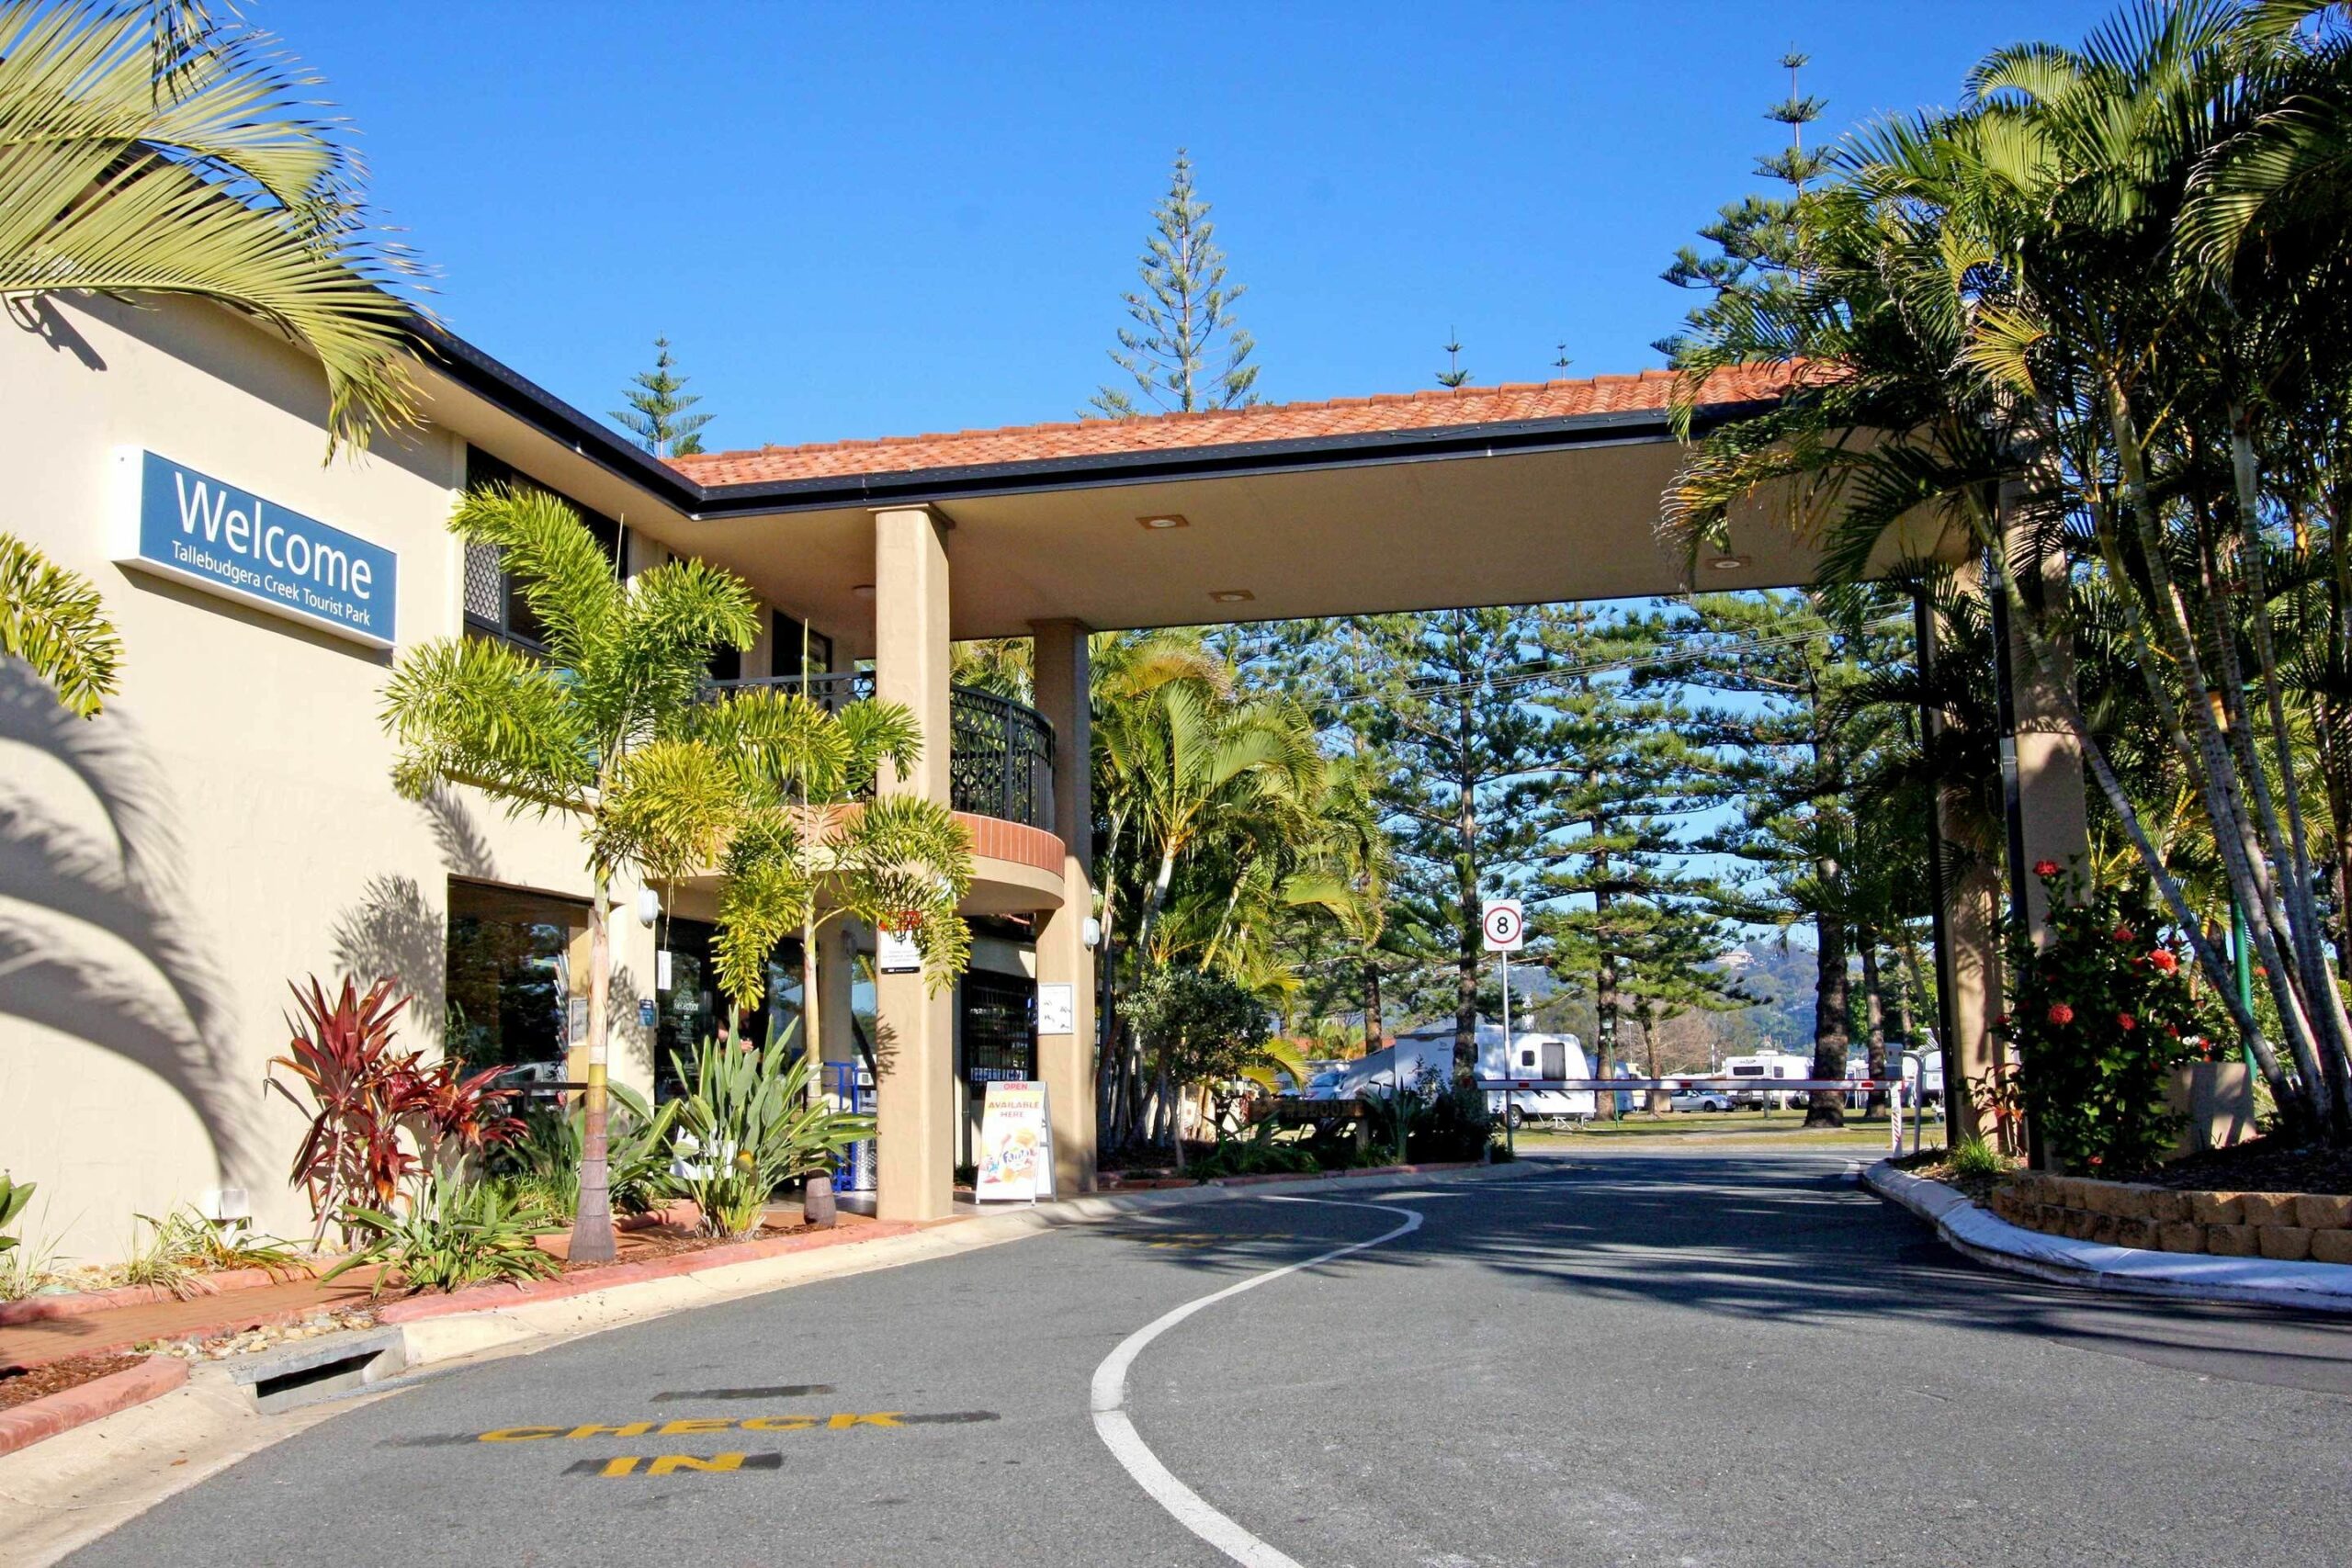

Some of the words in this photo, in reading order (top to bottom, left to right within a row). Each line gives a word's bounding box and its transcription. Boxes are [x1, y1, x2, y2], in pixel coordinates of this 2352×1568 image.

[175, 471, 372, 599] Welcome
[172, 540, 261, 588] Tallebudgera
[265, 578, 300, 602] Creek
[302, 588, 344, 617] Tourist
[346, 604, 371, 626] Park
[1497, 917, 1509, 934] 8
[988, 1101, 1040, 1110] AVAILABLE
[478, 1410, 908, 1443] CHECK
[598, 1452, 747, 1478] IN
